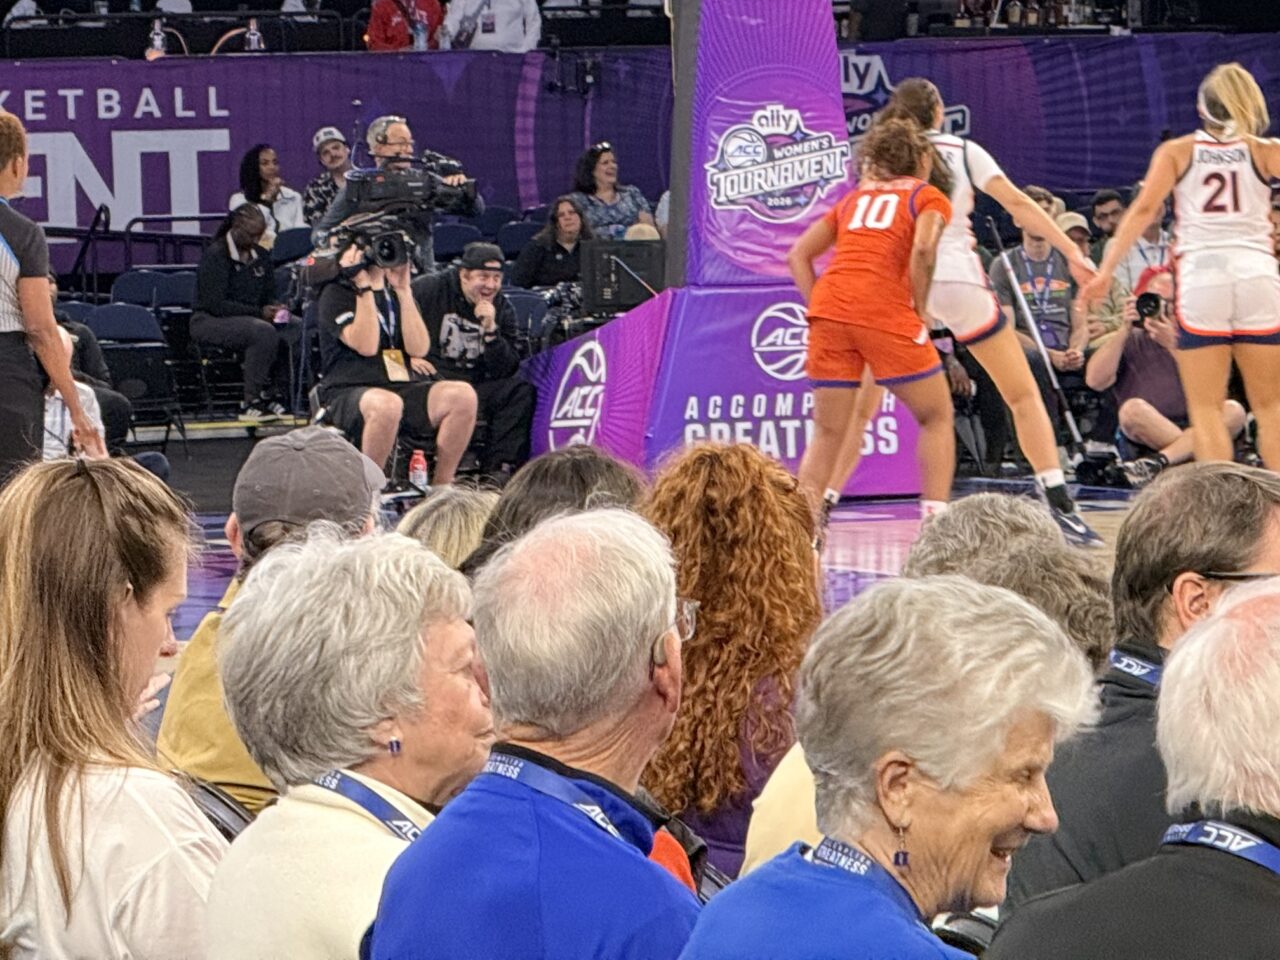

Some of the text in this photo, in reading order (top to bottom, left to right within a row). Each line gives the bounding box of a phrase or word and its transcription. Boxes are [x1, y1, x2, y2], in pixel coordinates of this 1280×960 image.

[757, 109, 793, 131] ally
[731, 144, 763, 157] ACC
[773, 137, 831, 159] WOMEN'S
[712, 146, 849, 204] TOURNAMENT
[1203, 170, 1241, 213] 21
[848, 193, 900, 231] 10
[684, 392, 897, 421] ACCOMPH
[1198, 826, 1258, 852] ACC
